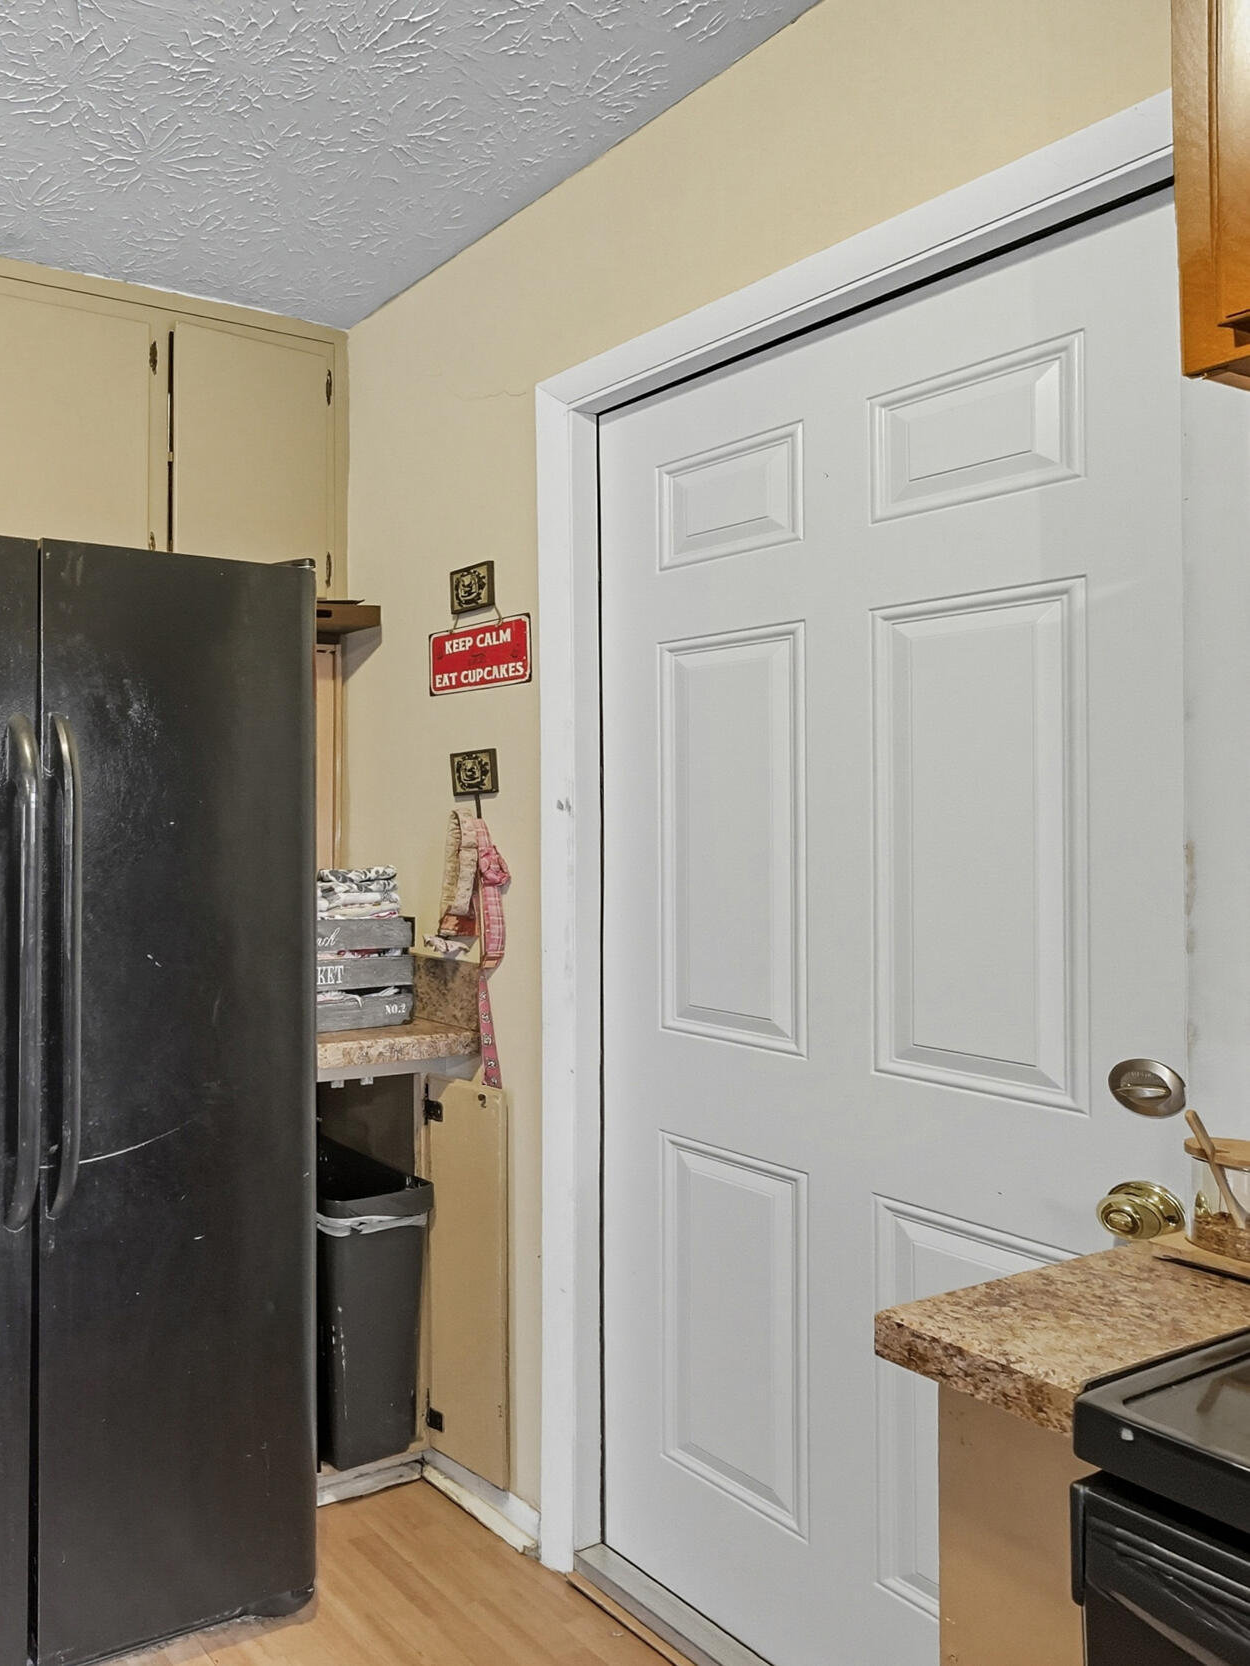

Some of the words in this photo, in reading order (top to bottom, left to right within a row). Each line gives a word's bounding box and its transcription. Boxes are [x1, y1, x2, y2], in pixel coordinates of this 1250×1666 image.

[445, 637, 473, 655] KEEP
[476, 628, 512, 648] CALM
[435, 672, 458, 688] EAT
[460, 662, 525, 684] CUPCAKES
[316, 965, 344, 985] KET
[385, 1003, 406, 1015] NO.2
